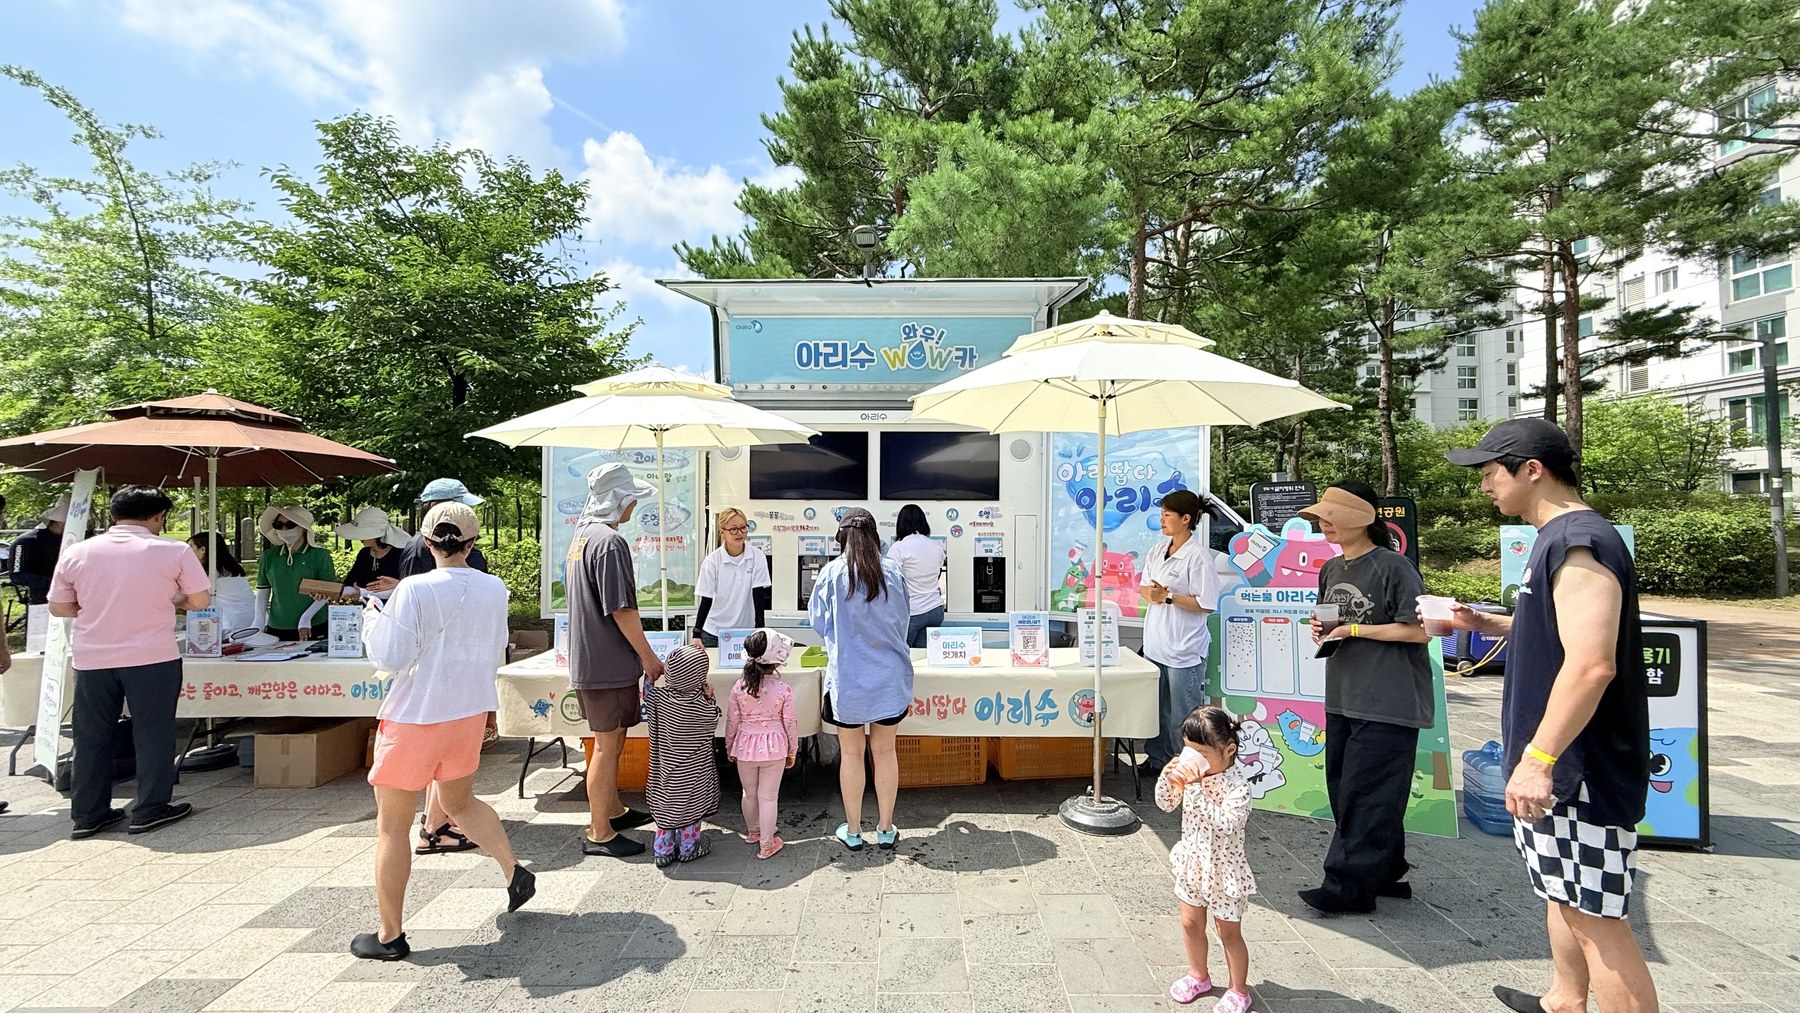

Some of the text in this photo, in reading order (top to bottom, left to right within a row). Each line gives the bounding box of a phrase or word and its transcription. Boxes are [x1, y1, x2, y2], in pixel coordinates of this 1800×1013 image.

[902, 323, 945, 345] 와우!
[796, 342, 876, 369] 아리수
[860, 413, 887, 421] 아리수
[1241, 590, 1318, 603] 먹는물 아리수
[942, 641, 966, 650] 아리수
[1646, 667, 1664, 685] 함
[203, 682, 242, 700] 줄이고,
[247, 680, 298, 699] 깨끗함은
[907, 688, 1060, 728] 리땁다 아리수
